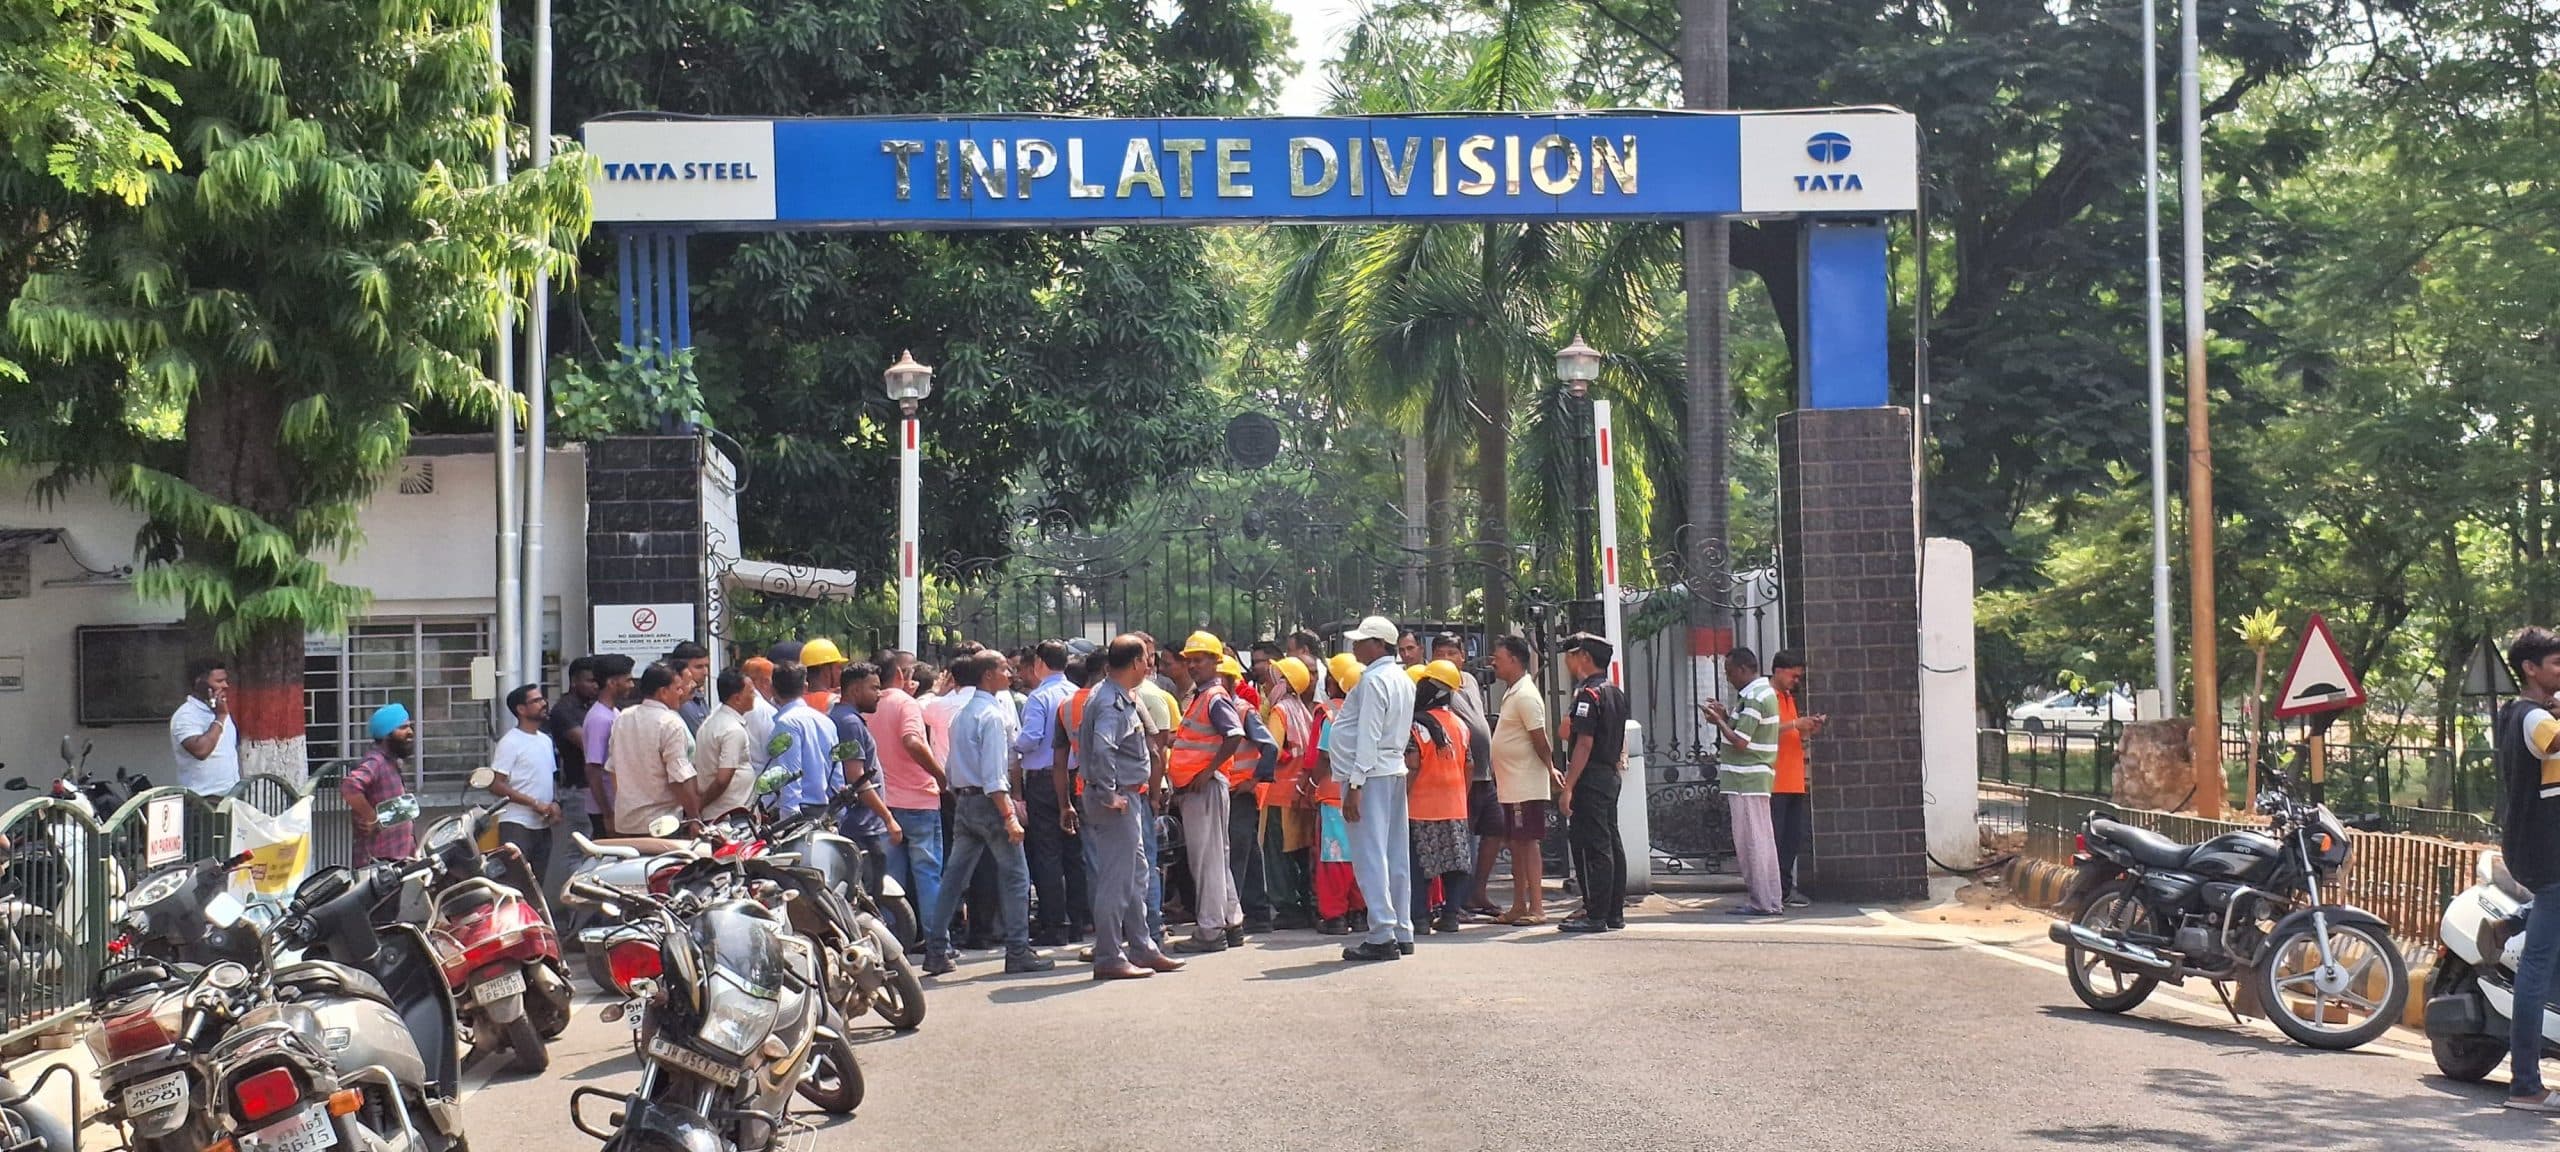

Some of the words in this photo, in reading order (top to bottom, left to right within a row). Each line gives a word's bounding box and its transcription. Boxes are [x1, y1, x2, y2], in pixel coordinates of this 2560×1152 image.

[604, 163, 677, 180] TATA
[684, 162, 758, 180] STEEL
[881, 138, 1254, 199] TINPLATE
[1289, 134, 1638, 196] DIVISION
[1793, 174, 1863, 191] TATA
[151, 840, 158, 855] NO
[159, 835, 181, 852] PARKING
